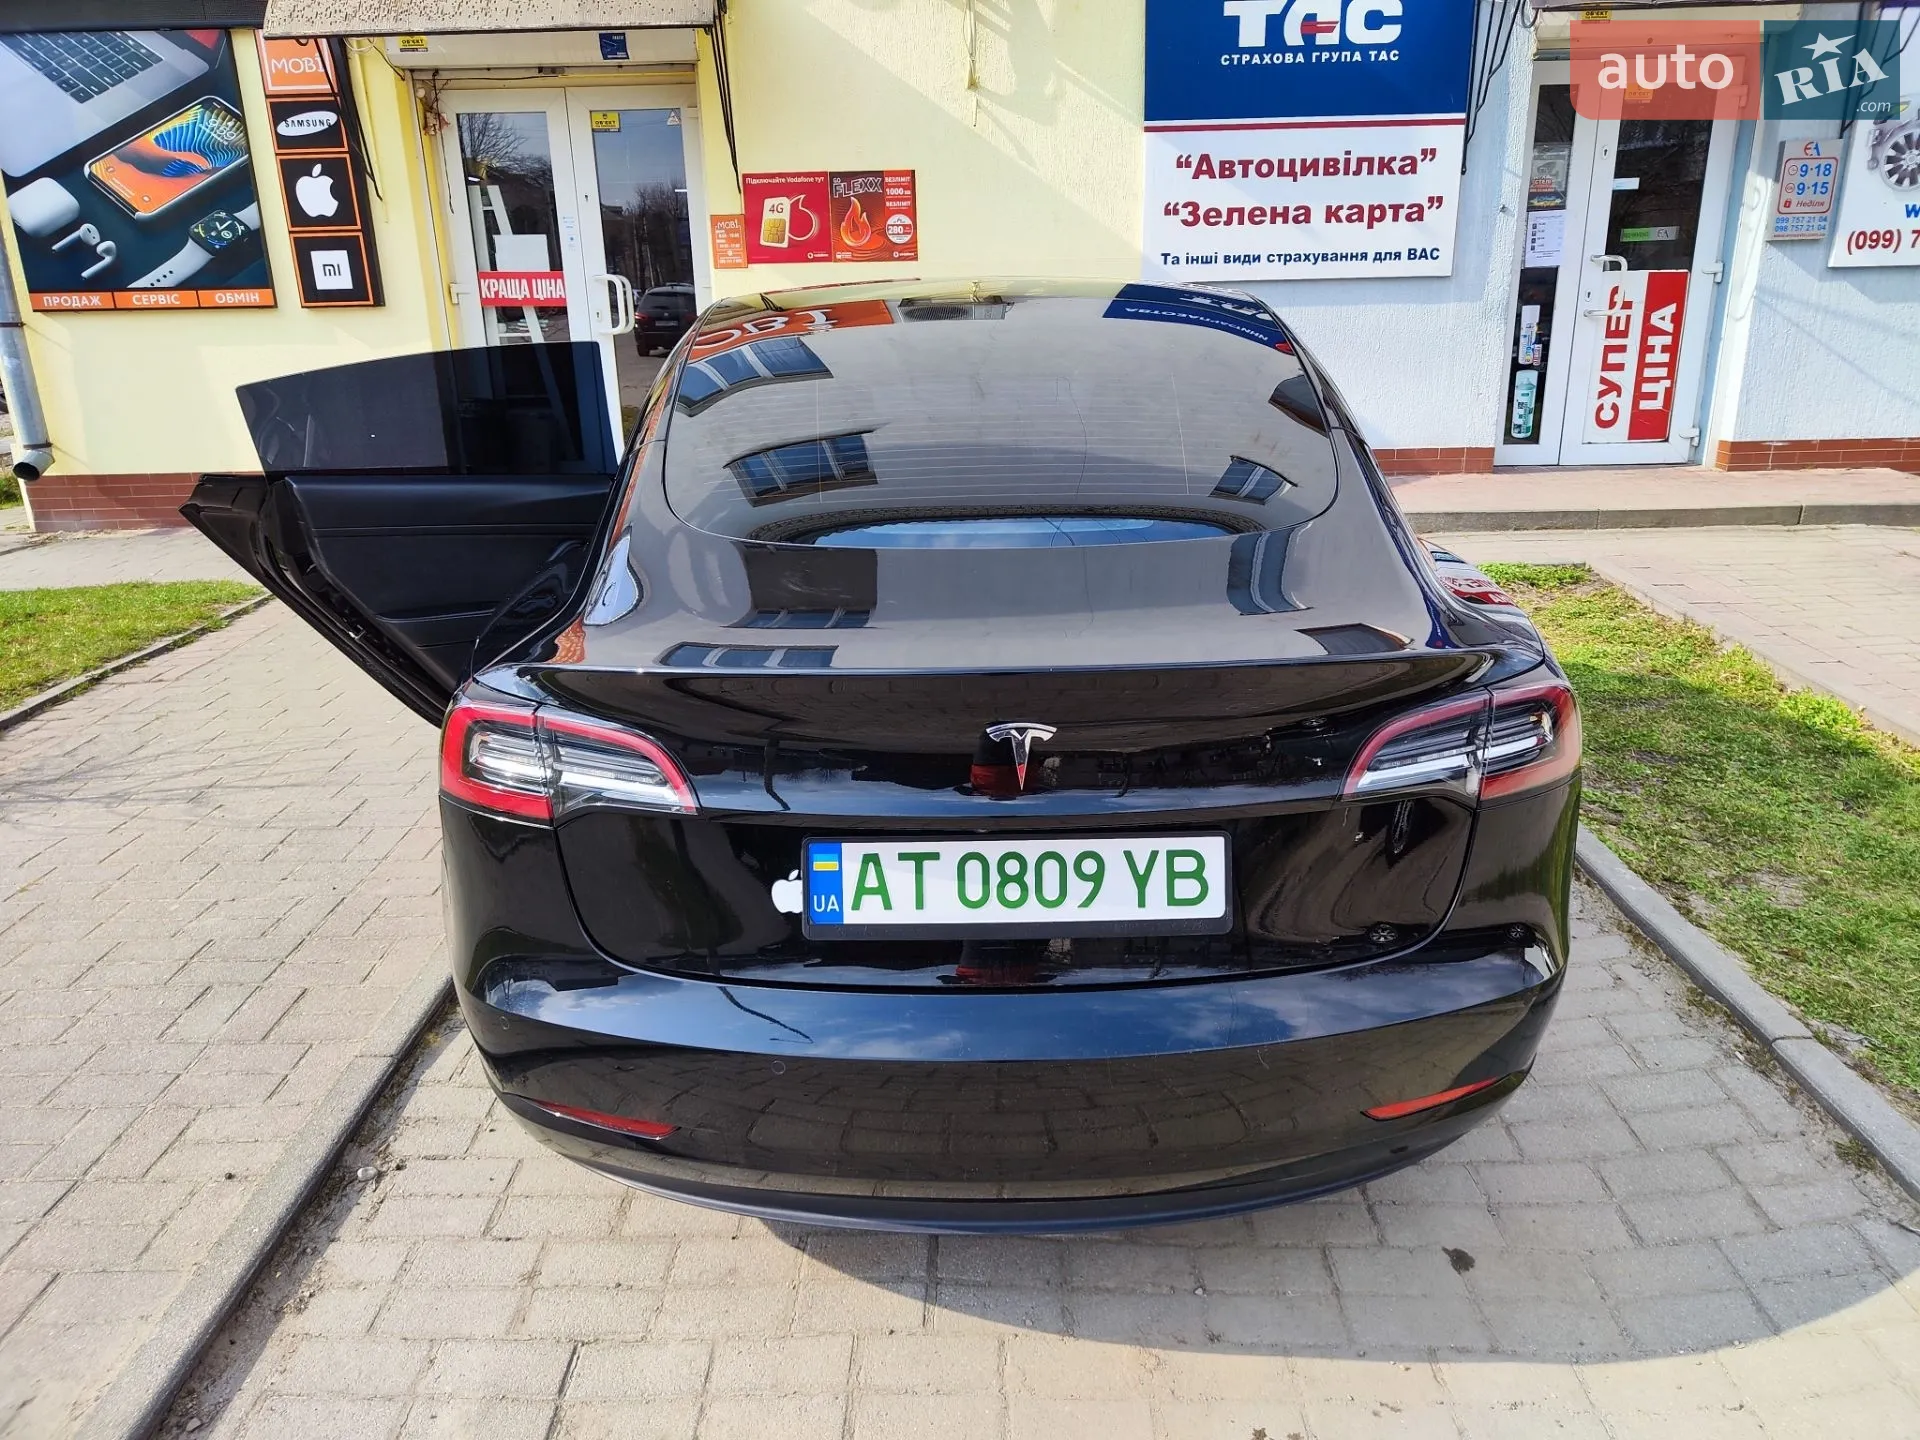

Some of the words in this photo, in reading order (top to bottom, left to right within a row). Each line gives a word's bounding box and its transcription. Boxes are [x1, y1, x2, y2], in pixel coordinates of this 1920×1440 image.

[1223, 0, 1404, 47] ТАС
[1220, 52, 1305, 66] СТРАХОВА
[1311, 51, 1362, 64] ГРУПА
[1368, 50, 1400, 62] ТАС
[284, 118, 332, 129] SAMSUNG
[1175, 148, 1437, 182] “Автоцивілка”
[832, 177, 883, 198] FLEXX
[768, 202, 784, 214] 4G
[1163, 200, 1312, 227] “Зелена
[1324, 195, 1444, 230] карта”
[1847, 228, 1902, 256] (099)
[1161, 252, 1180, 266] Та
[1185, 252, 1218, 265] інші
[1223, 253, 1262, 265] види
[1266, 252, 1369, 264] страхування
[1372, 251, 1402, 262] для
[1406, 247, 1441, 261] ВАС
[132, 293, 181, 306] СЕРВІС
[214, 292, 260, 305] ОБМІН
[479, 278, 531, 301] КРАЩА
[531, 278, 566, 301] ЦІНА
[43, 295, 102, 308] ПРОДАЖ
[1594, 285, 1634, 429] СУПЕР
[1639, 302, 1678, 410] ЦІНА
[850, 851, 941, 911] AT
[955, 850, 1106, 910] 0809
[1122, 848, 1209, 909] YB
[813, 894, 840, 913] UA
